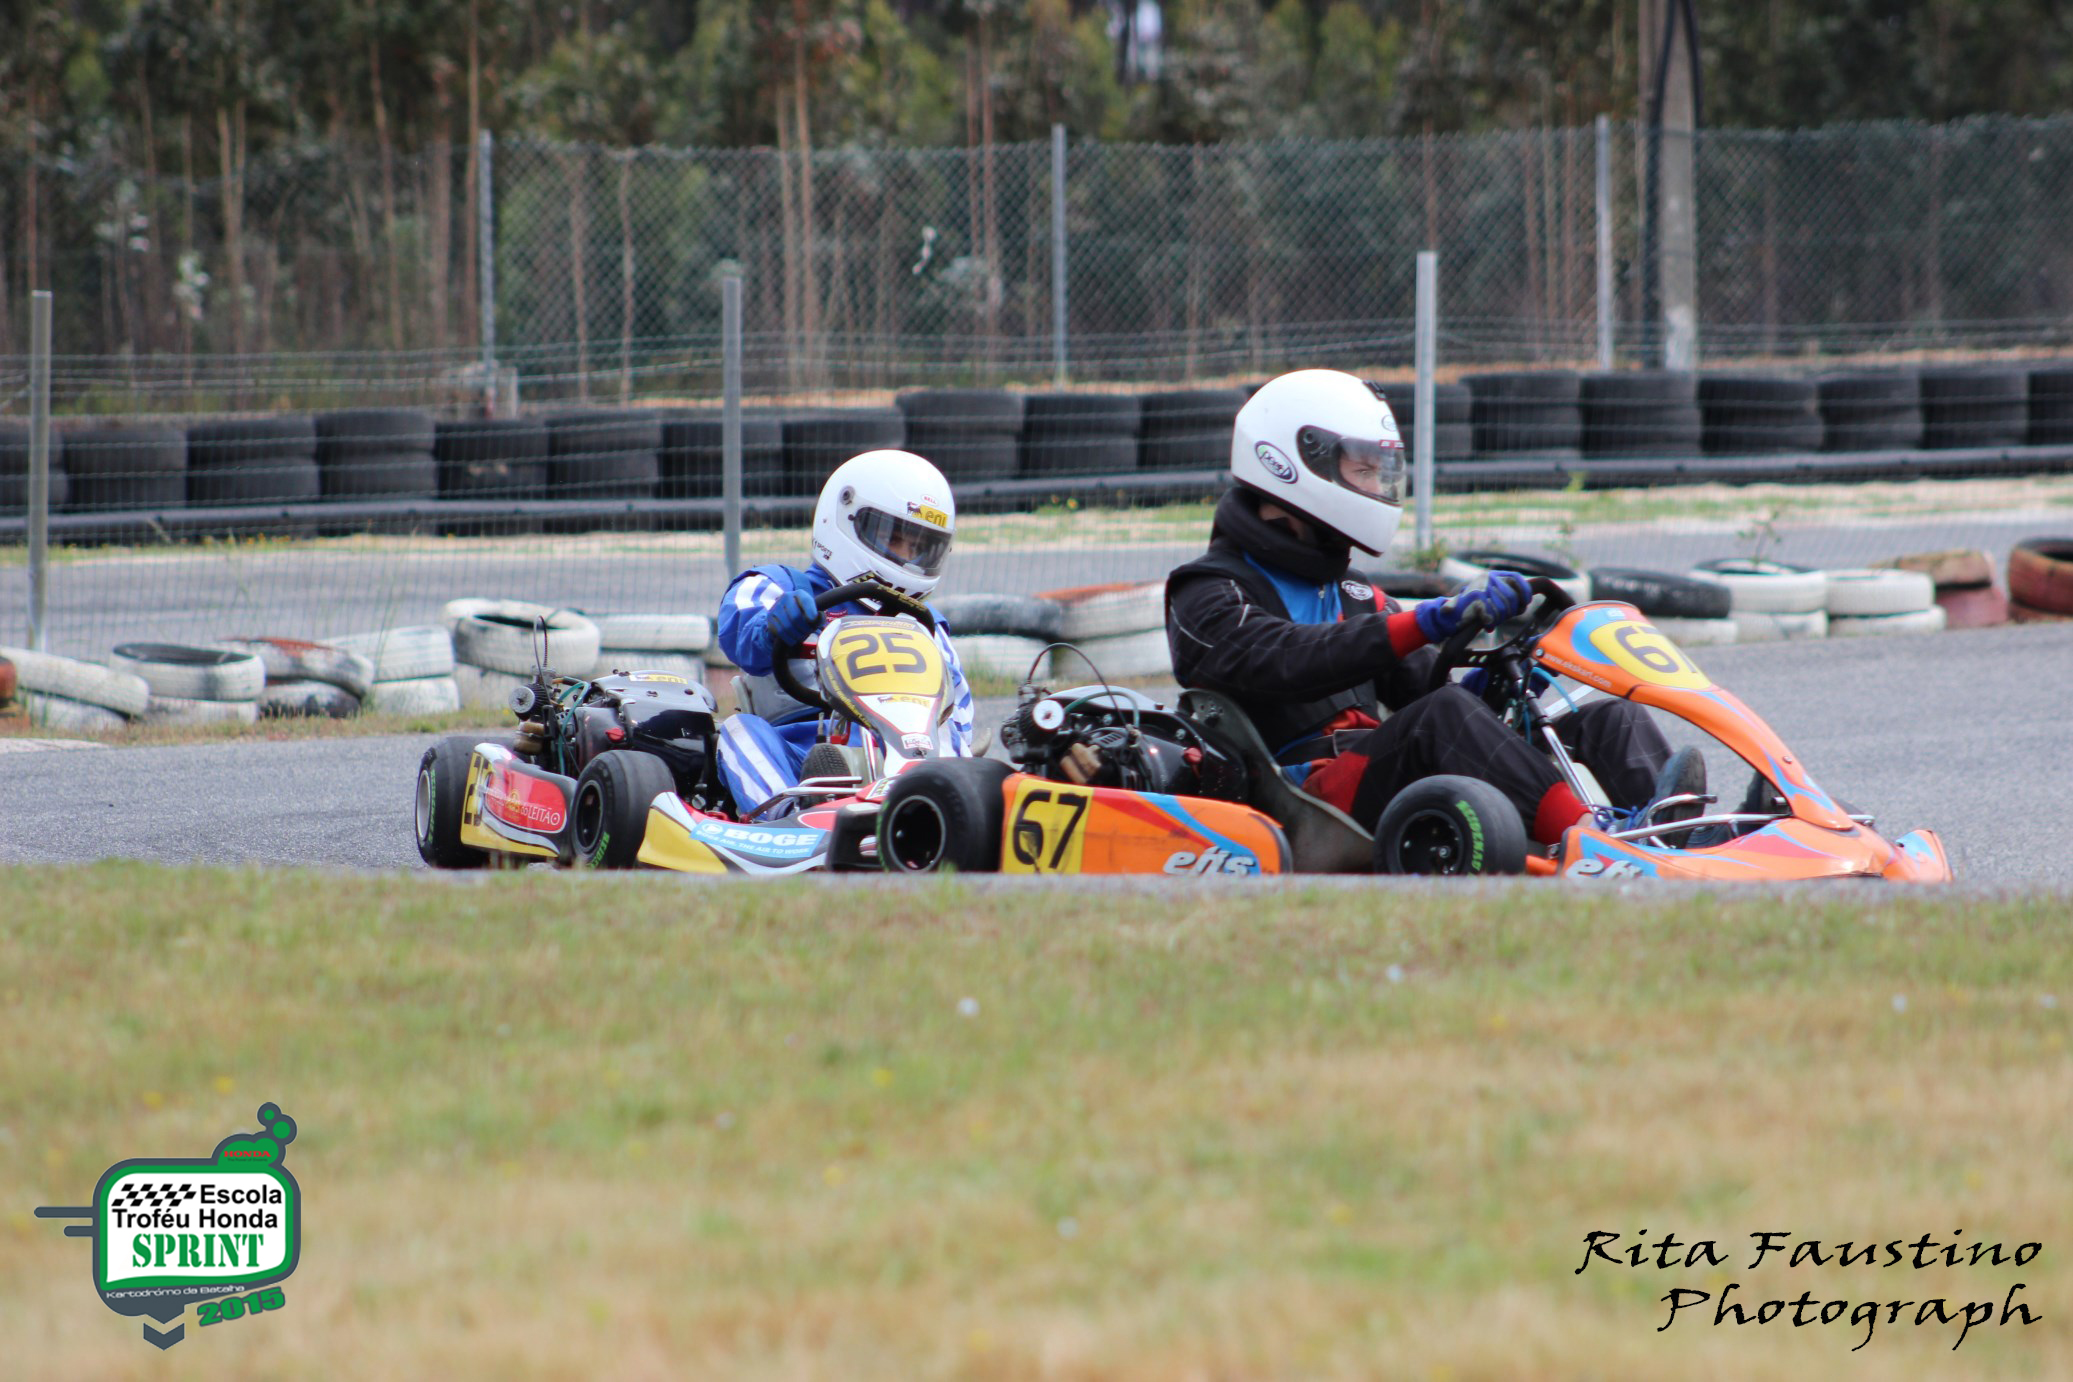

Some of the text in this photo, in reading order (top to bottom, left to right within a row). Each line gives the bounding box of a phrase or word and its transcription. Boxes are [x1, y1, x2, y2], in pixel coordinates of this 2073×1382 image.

[925, 510, 946, 528] eni
[839, 632, 928, 681] 25
[528, 805, 561, 826] LEITÃO
[724, 828, 818, 847] BOGE
[1012, 788, 1089, 870] 67
